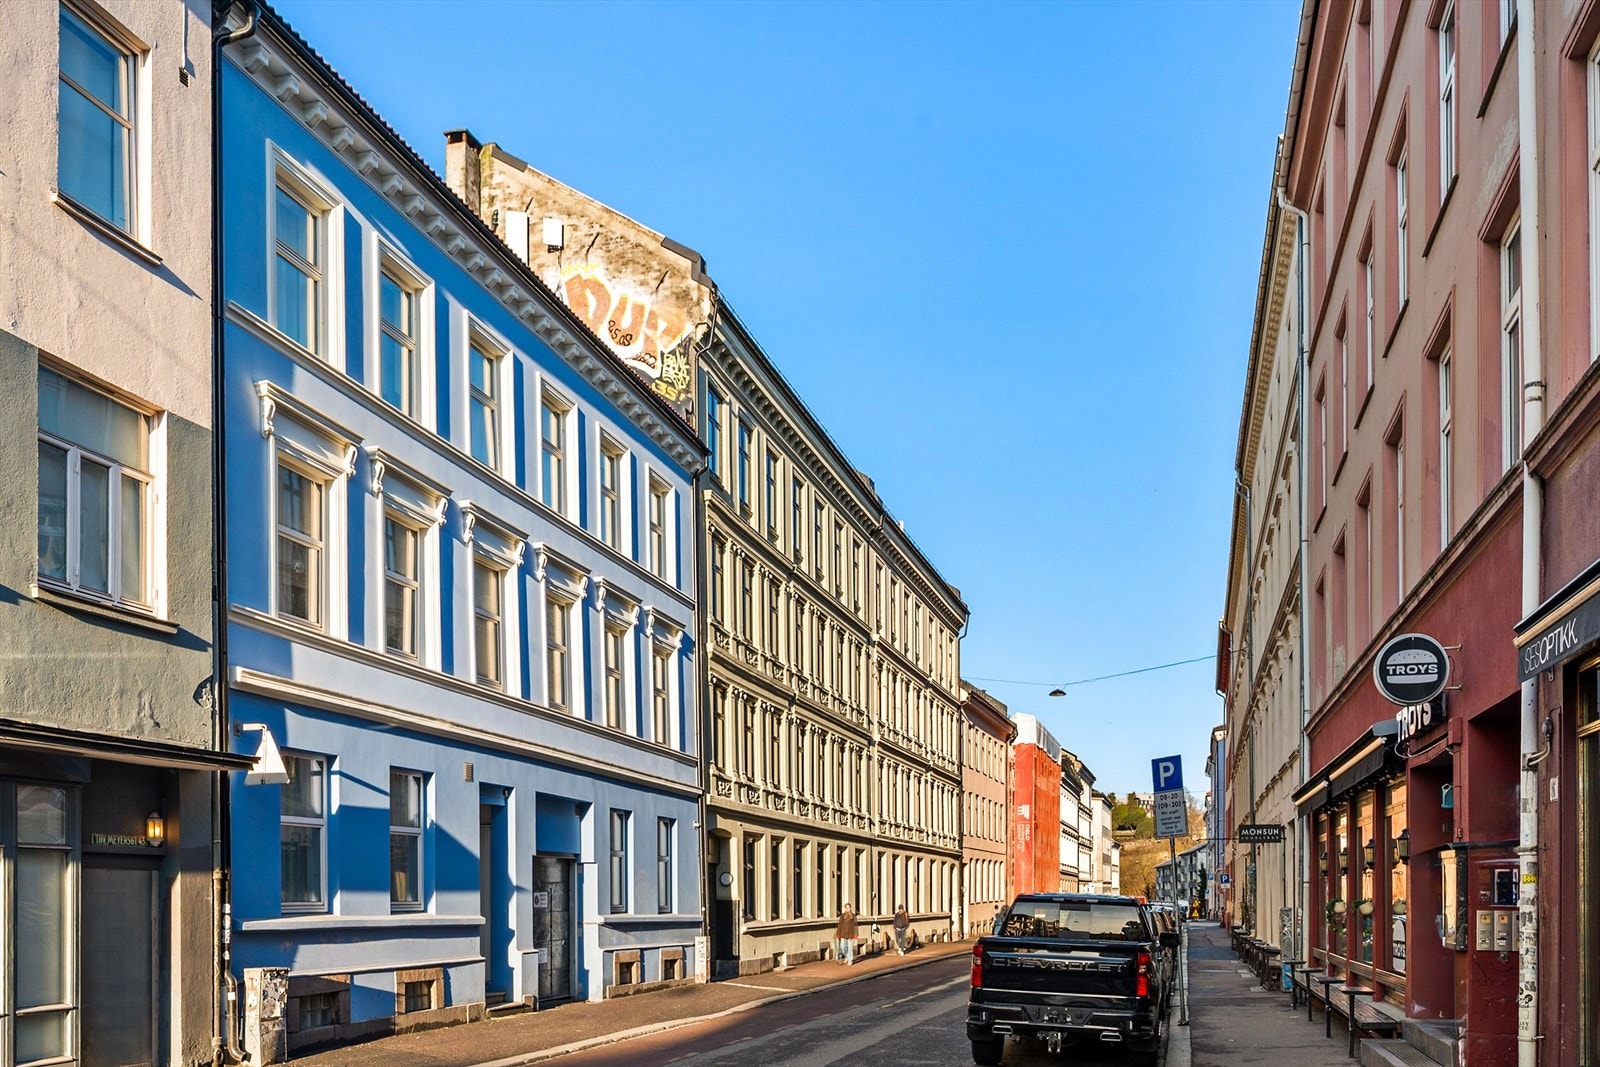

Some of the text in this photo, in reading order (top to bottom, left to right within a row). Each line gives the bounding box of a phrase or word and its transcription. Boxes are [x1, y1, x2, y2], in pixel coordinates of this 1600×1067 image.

[1386, 664, 1439, 675] TROYS
[1396, 702, 1432, 742] TROYS
[1158, 761, 1175, 788] P
[992, 958, 1127, 973] CHEVROLET
